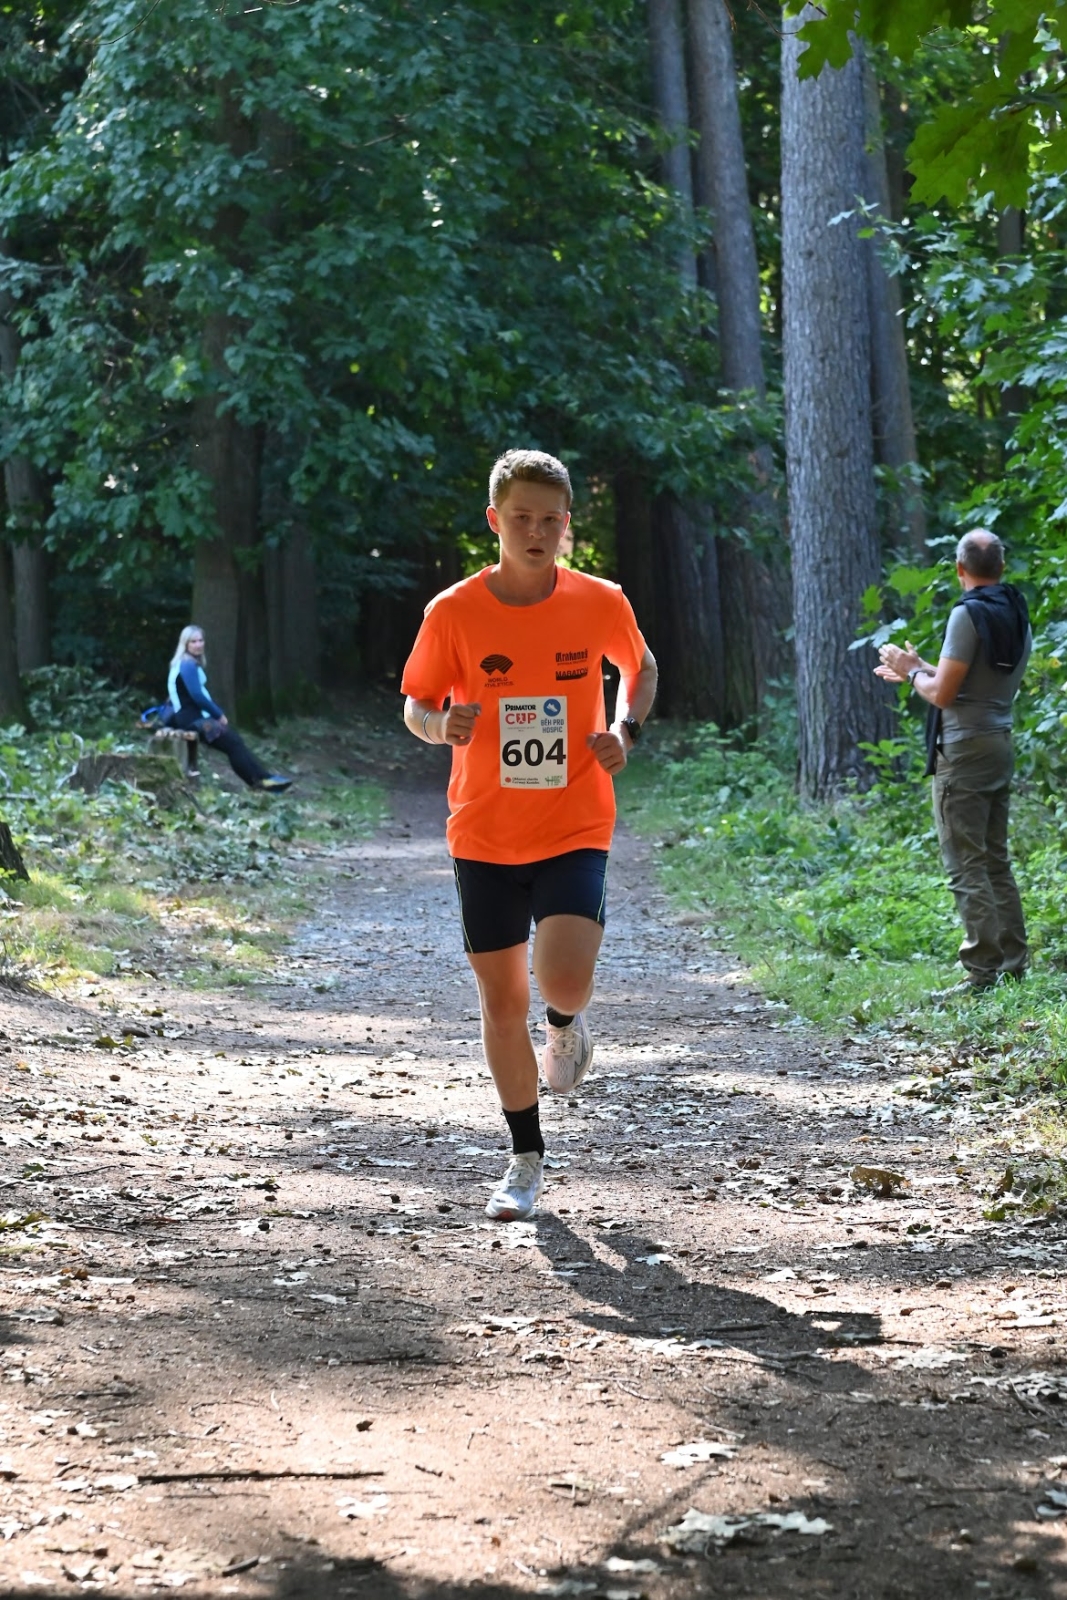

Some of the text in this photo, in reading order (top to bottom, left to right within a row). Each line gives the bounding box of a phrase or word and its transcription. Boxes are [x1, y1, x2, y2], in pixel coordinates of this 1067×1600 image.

[555, 667, 588, 677] MARATON
[505, 704, 536, 712] PRIMATOR
[505, 713, 536, 724] CUP
[553, 718, 564, 726] PRO
[542, 726, 563, 734] HOSPIC
[502, 738, 566, 766] 604
